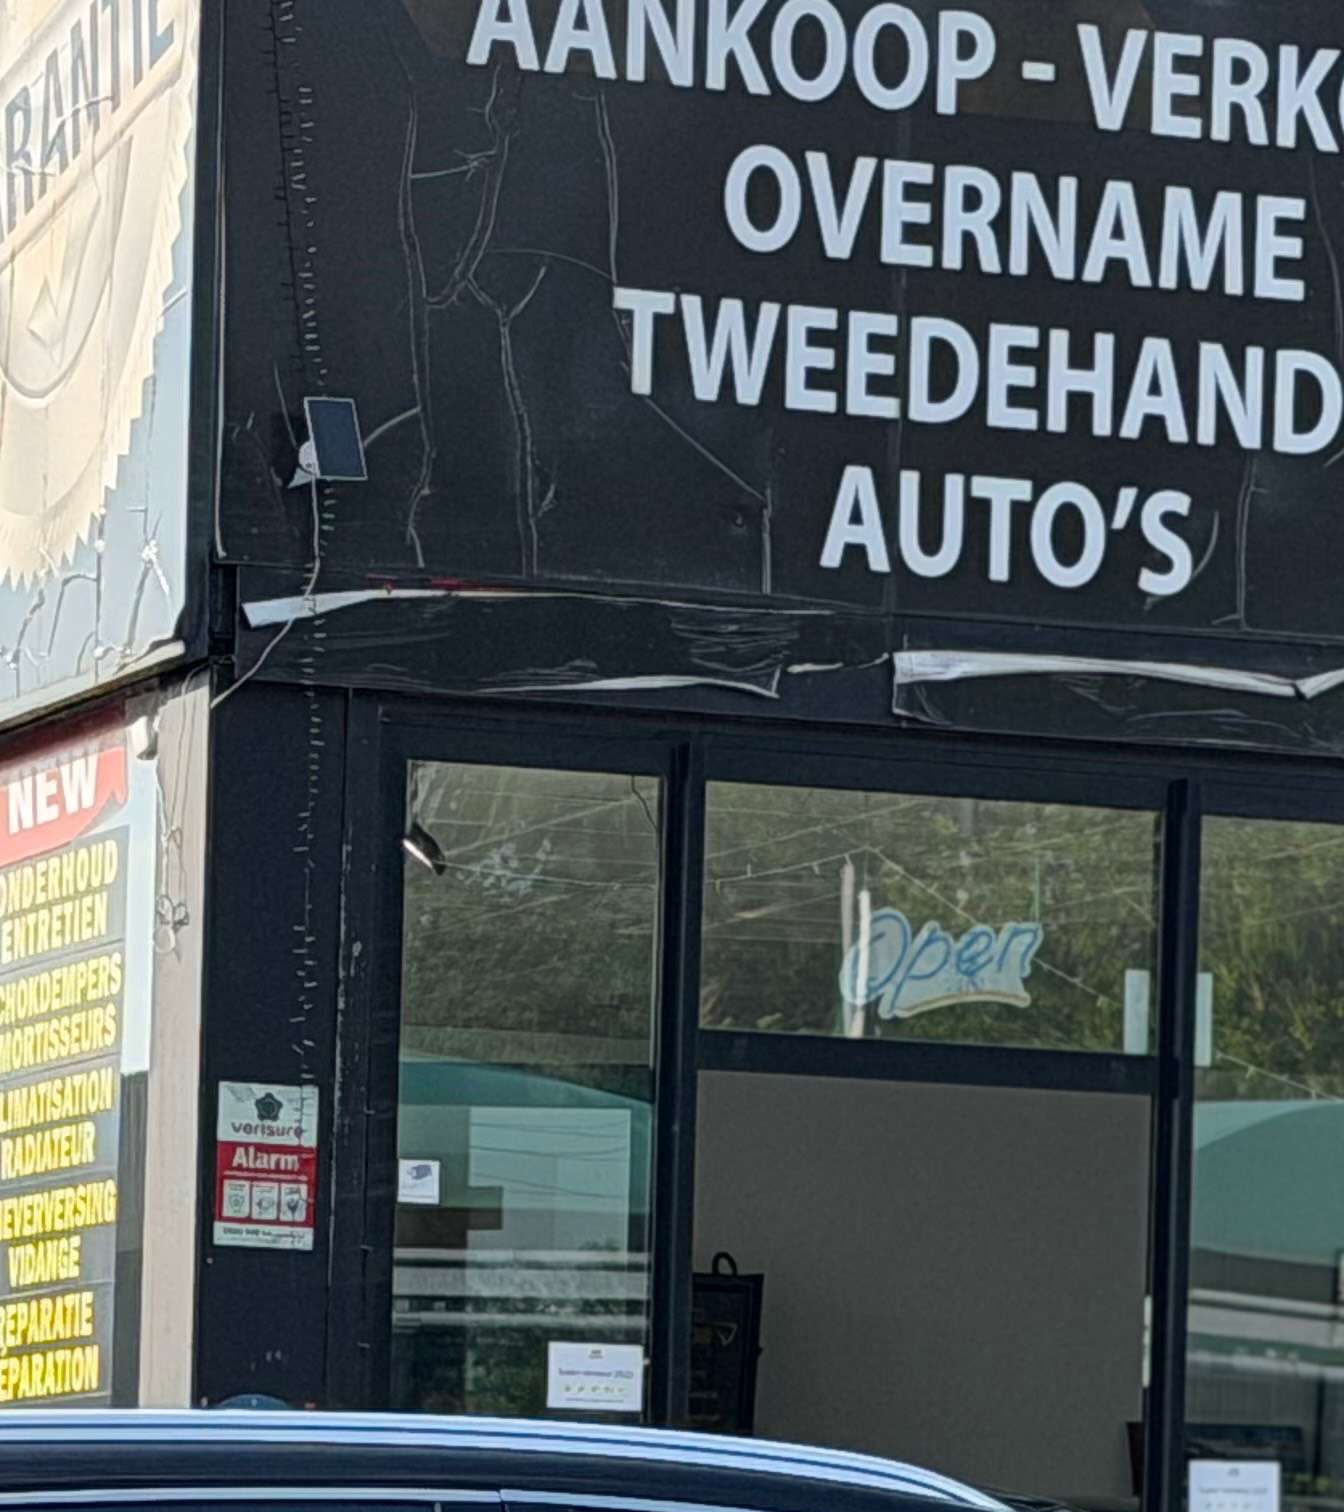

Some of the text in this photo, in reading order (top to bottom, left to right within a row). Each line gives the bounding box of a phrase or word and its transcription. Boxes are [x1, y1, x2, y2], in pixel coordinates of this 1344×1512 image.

[465, 0, 996, 114] AANKOOP
[723, 143, 1307, 303] OVERNAME
[8, 753, 99, 836] NEW
[1, 891, 107, 965] ENTRETIEN
[851, 911, 1038, 1012] Open
[0, 1120, 96, 1181] RADIATEUR
[231, 1121, 304, 1139] verisure
[232, 1146, 300, 1171] Alarm
[8, 1235, 81, 1288] VIDANGE
